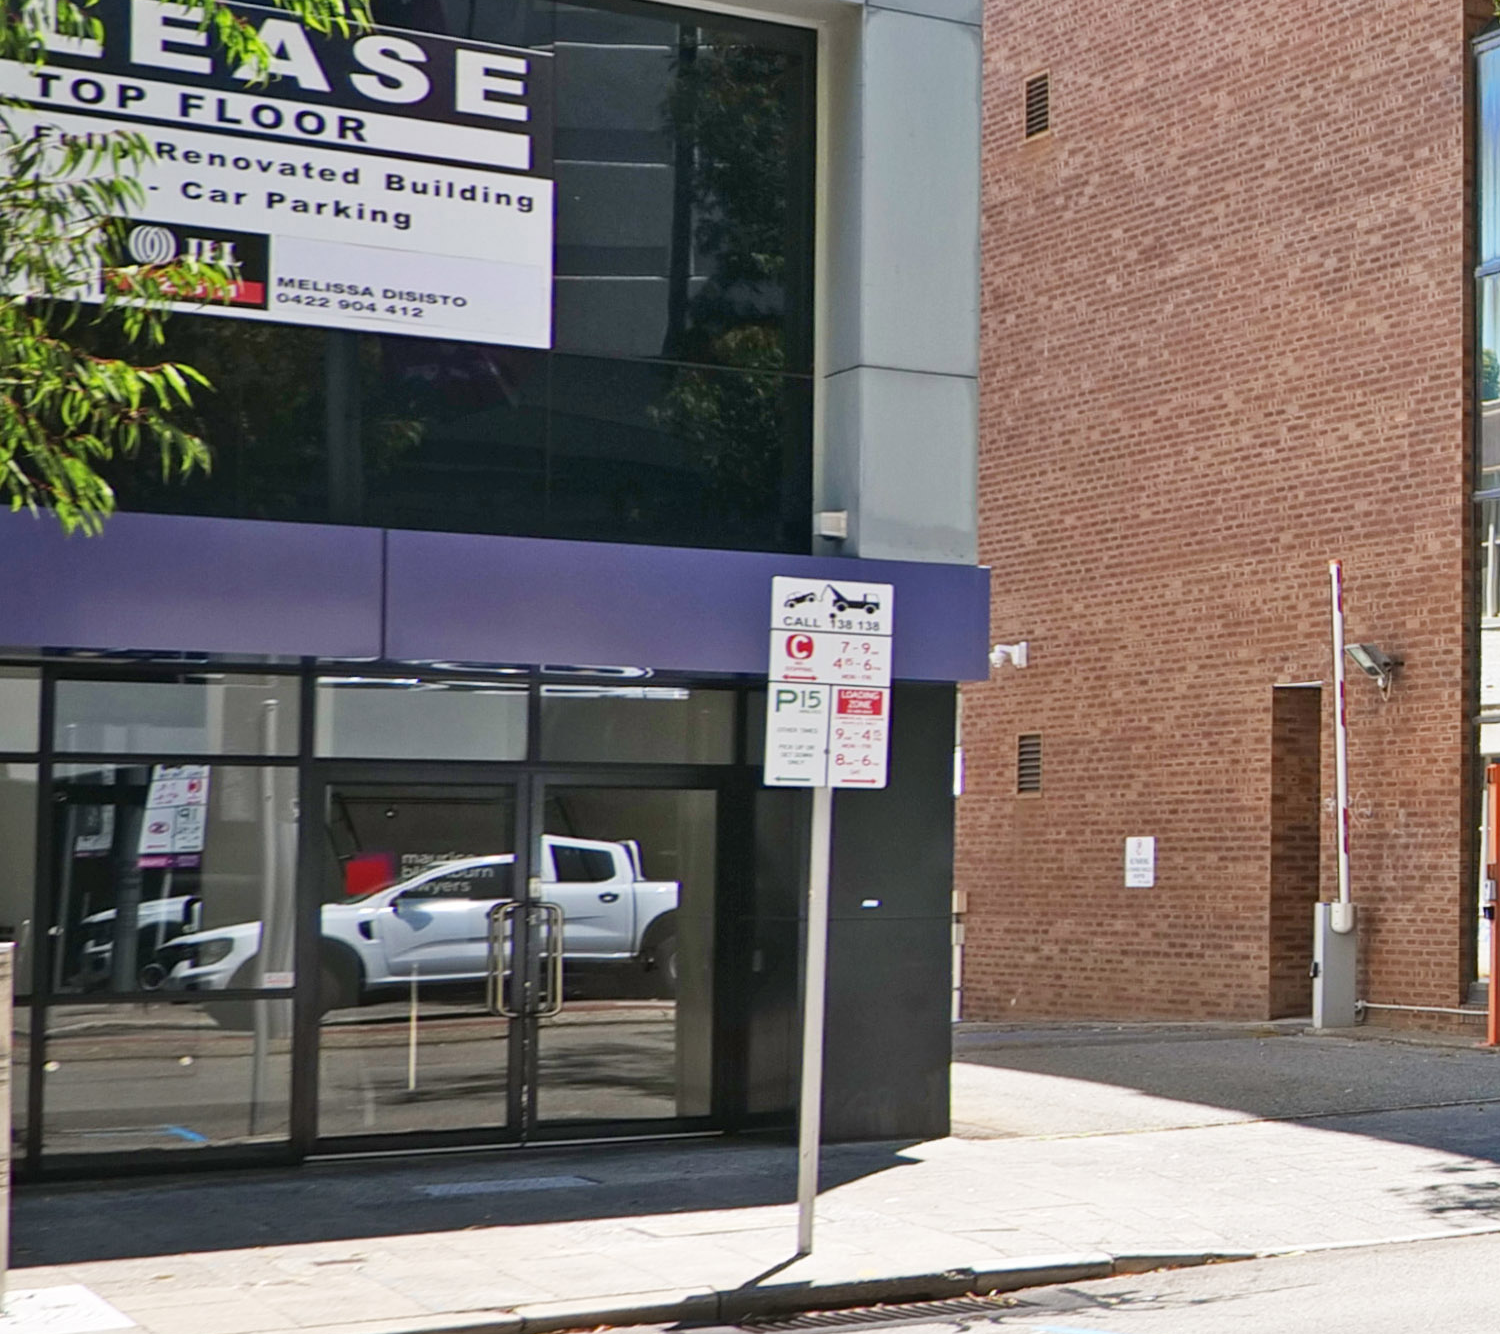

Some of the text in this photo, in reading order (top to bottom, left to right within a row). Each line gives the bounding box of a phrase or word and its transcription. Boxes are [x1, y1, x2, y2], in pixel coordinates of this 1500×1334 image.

[29, 70, 368, 143] TOP FLOOR
[155, 141, 361, 185] Renovated
[385, 173, 534, 214] Building
[181, 181, 412, 231] Car Parking
[276, 277, 468, 308] MELISSA DISISTO
[276, 292, 424, 319] 0422 904 412
[783, 616, 880, 632] CALL 138 138
